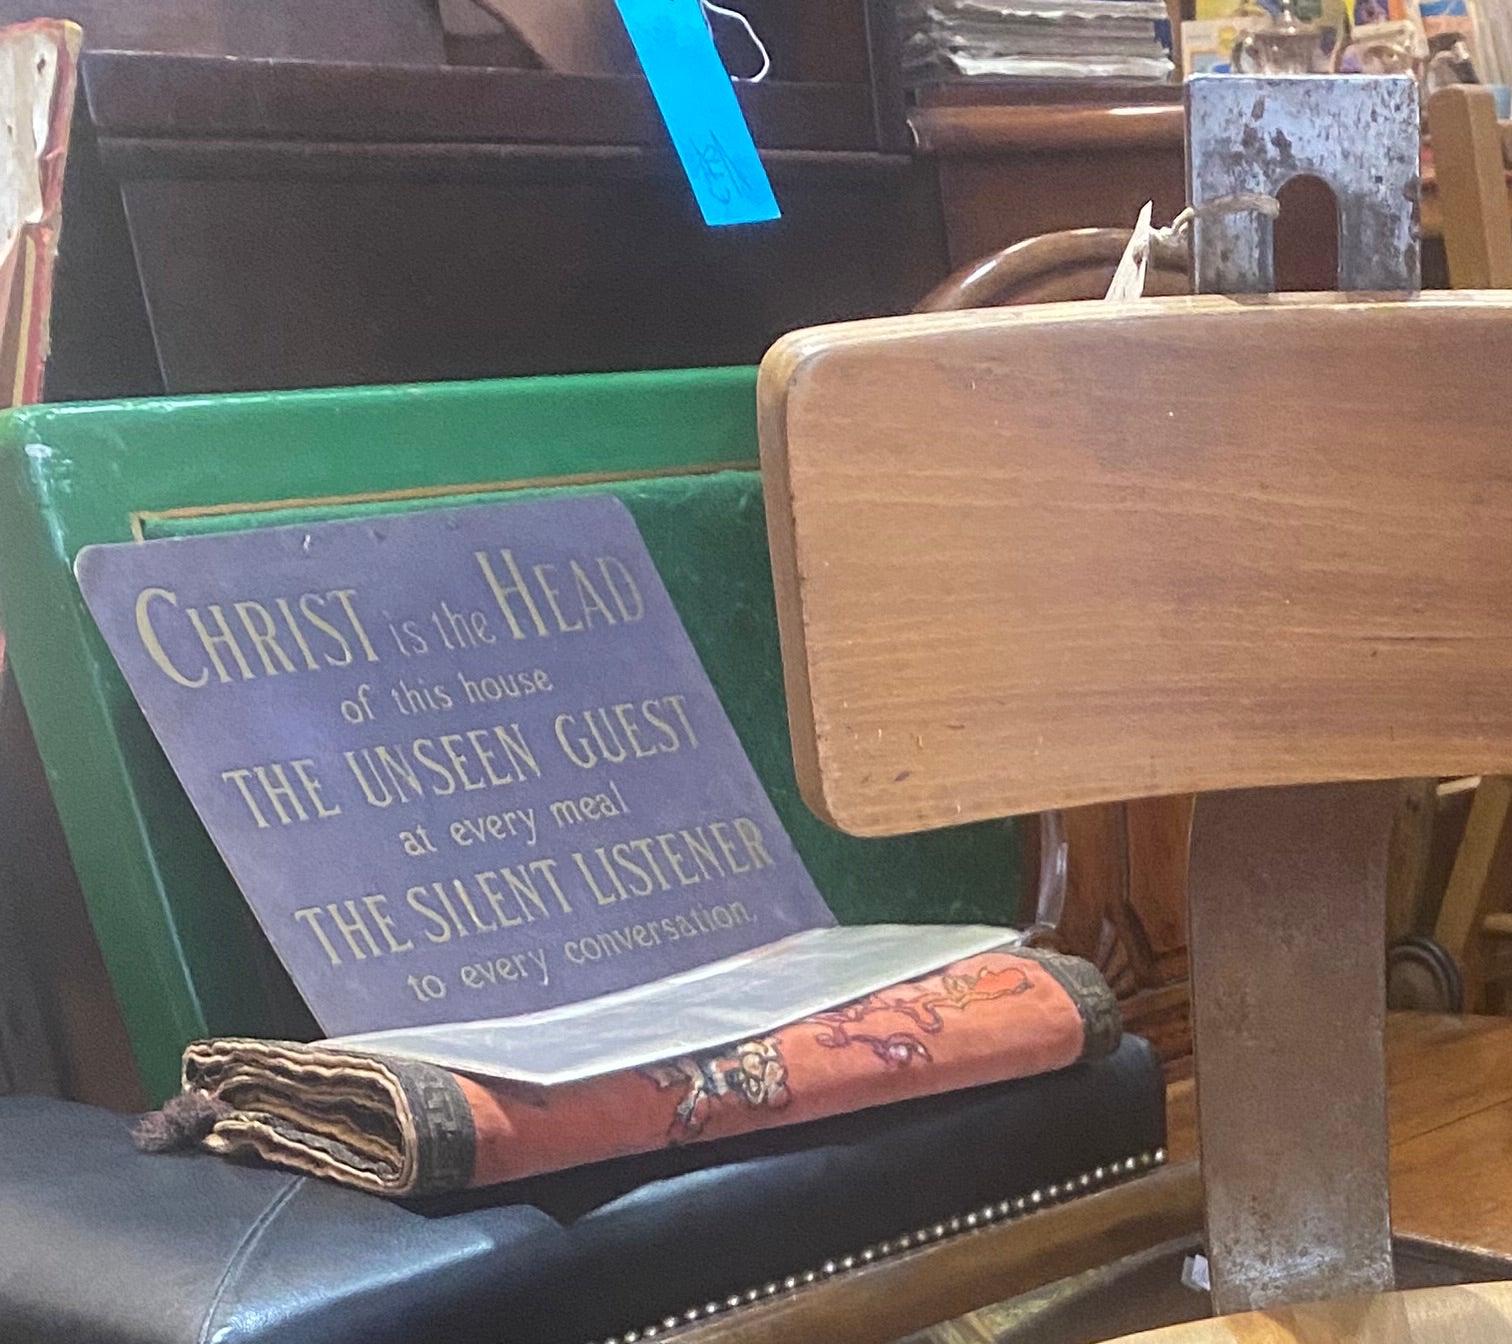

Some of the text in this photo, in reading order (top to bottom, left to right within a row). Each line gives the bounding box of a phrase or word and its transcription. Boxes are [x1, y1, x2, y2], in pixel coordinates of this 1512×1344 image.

[135, 548, 646, 688] CHRIST is the HEAD
[341, 665, 554, 724] of this house
[221, 695, 699, 828] THE UNSEEN GUEST
[399, 780, 630, 857] at every meal
[294, 816, 776, 965] THE SILENT LISTENER
[406, 972, 446, 1002] to
[460, 947, 550, 986] every
